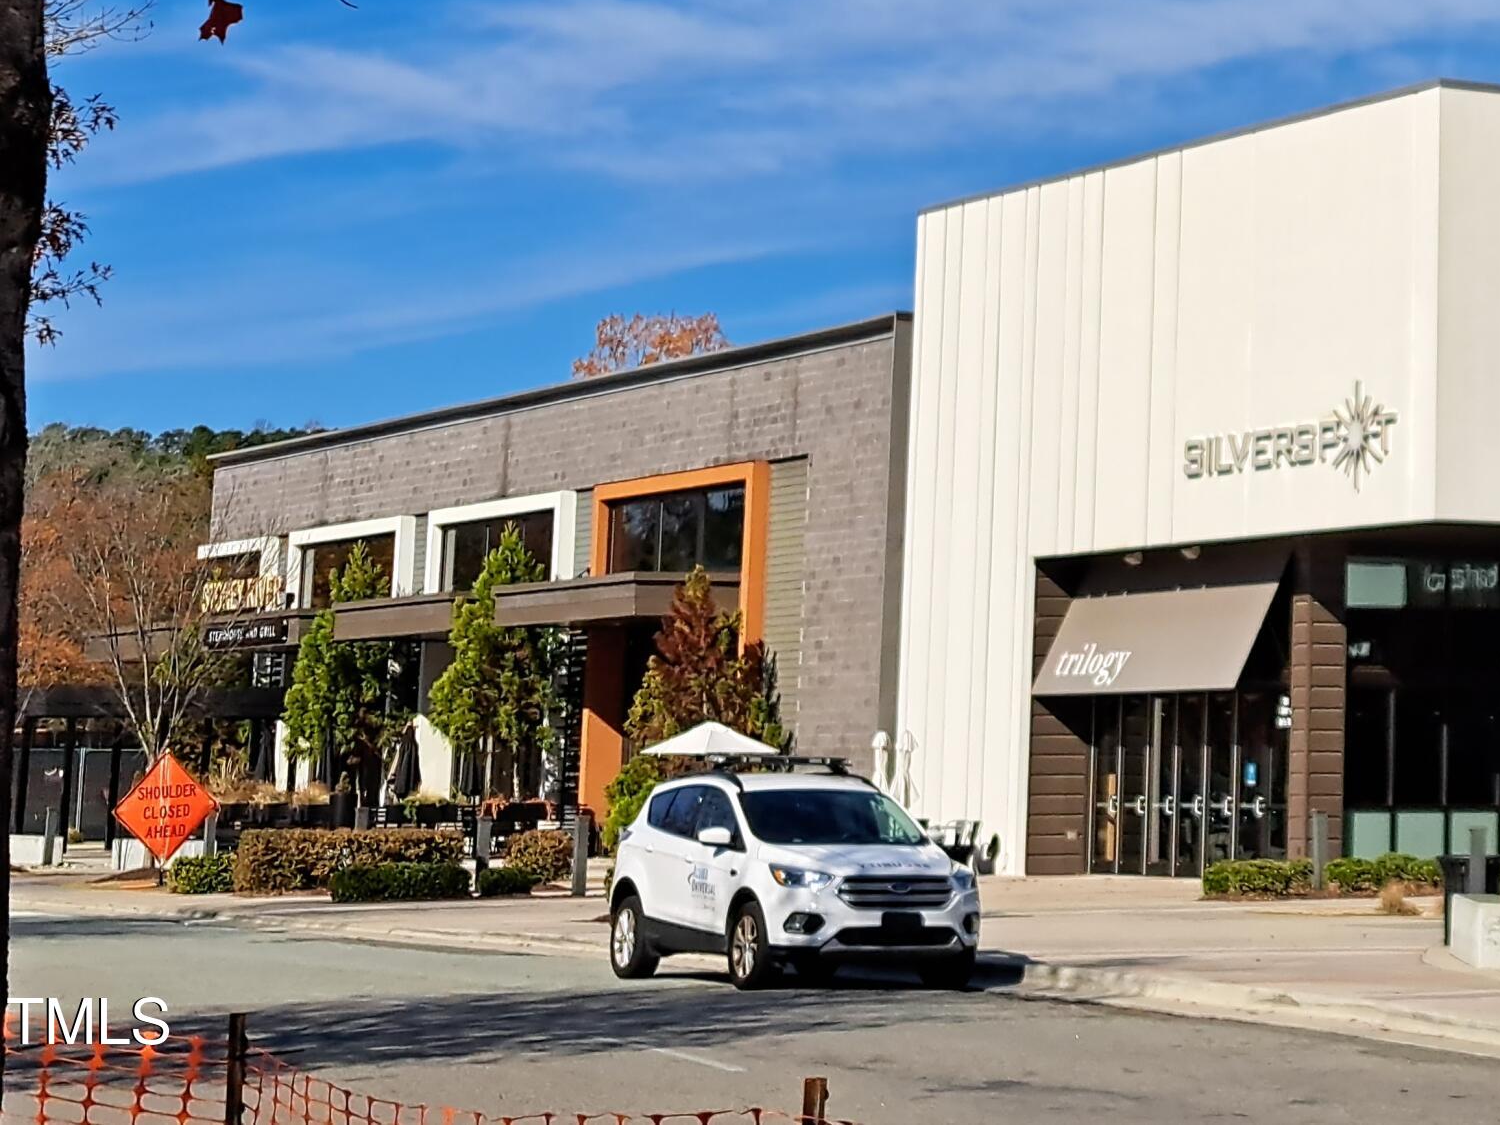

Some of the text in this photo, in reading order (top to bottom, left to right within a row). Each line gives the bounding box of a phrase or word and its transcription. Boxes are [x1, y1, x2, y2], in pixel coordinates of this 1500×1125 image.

[259, 625, 276, 639] GRILL
[1055, 642, 1132, 686] trilogy
[137, 783, 197, 801] SHOULDER
[143, 803, 190, 820] CLOSED
[145, 823, 187, 839] AHEAD
